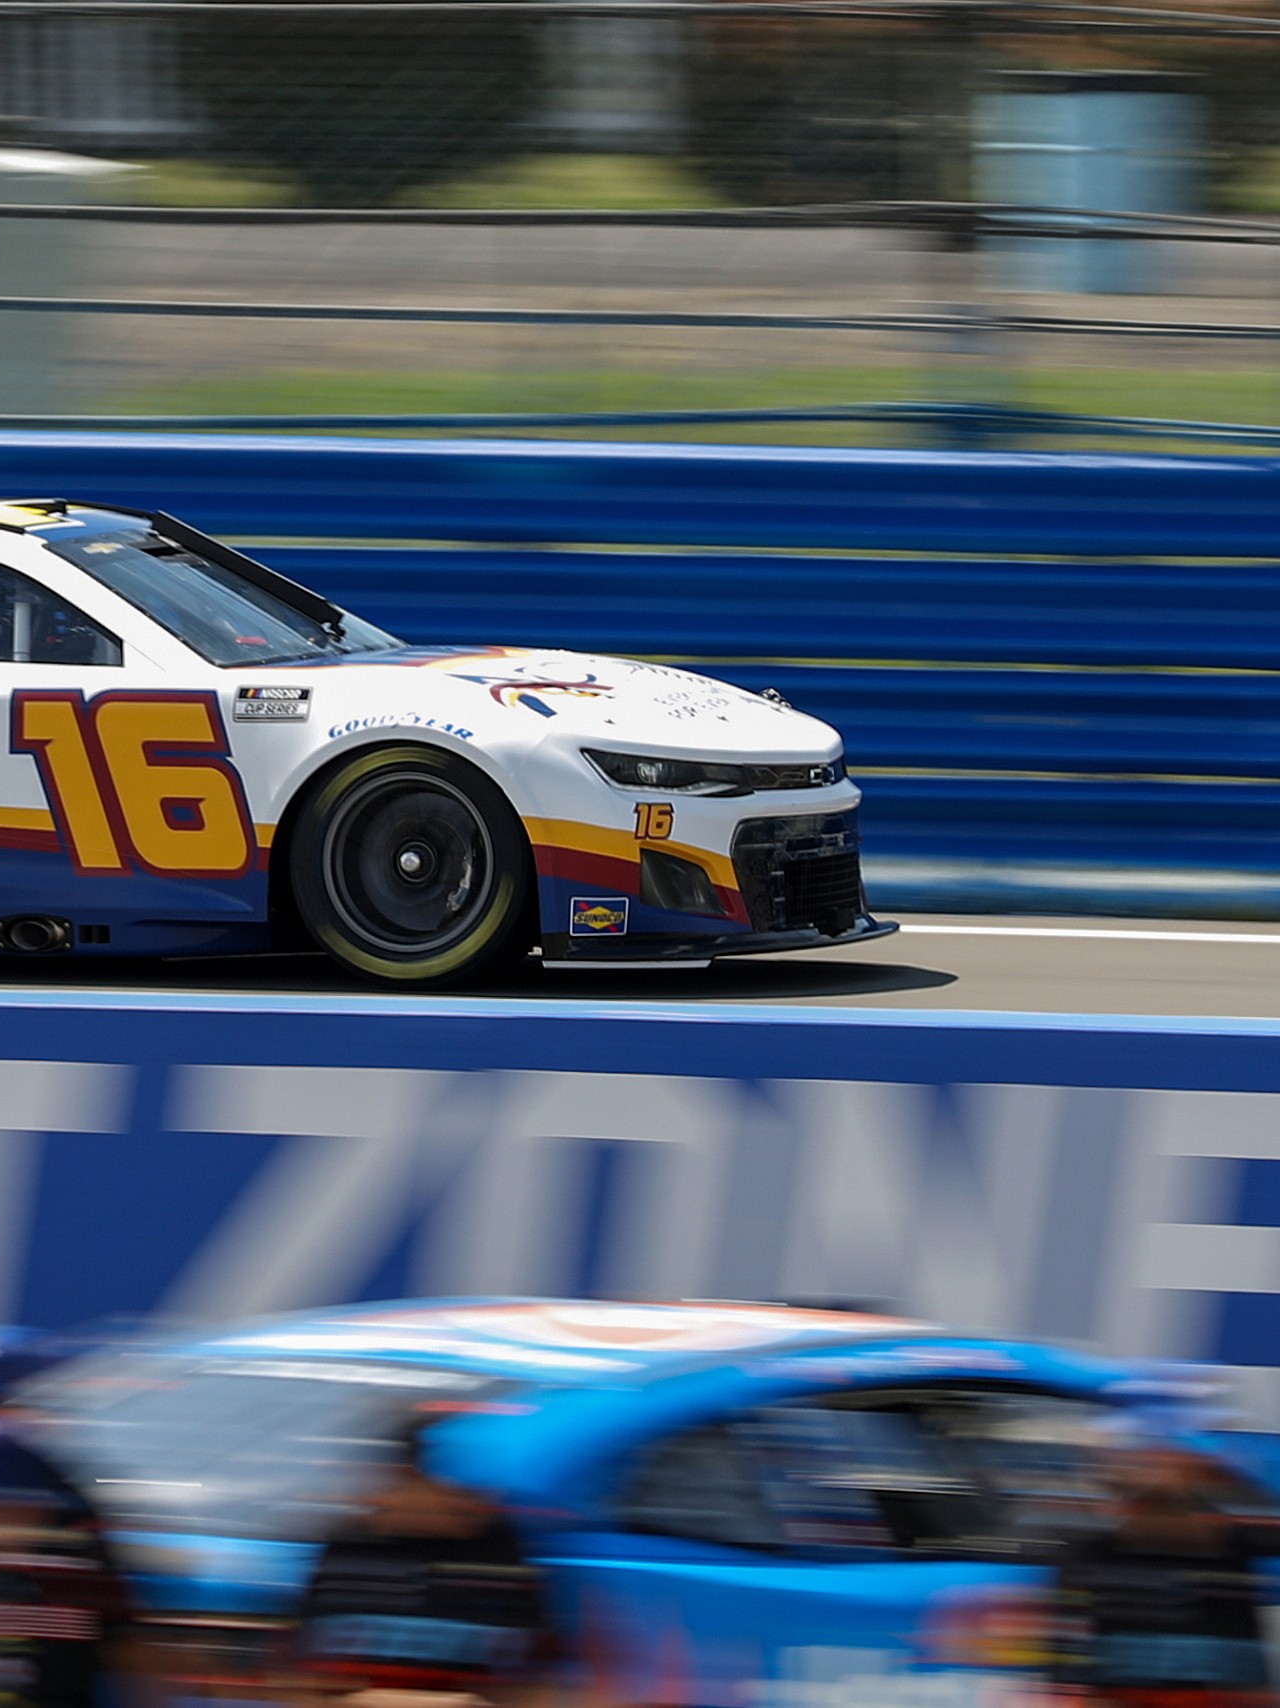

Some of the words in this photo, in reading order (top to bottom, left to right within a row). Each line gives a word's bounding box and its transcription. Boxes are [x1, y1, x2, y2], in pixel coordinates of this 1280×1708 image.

[9, 688, 258, 879] 16
[634, 802, 674, 840] 16
[574, 911, 625, 925] SUNOCO
